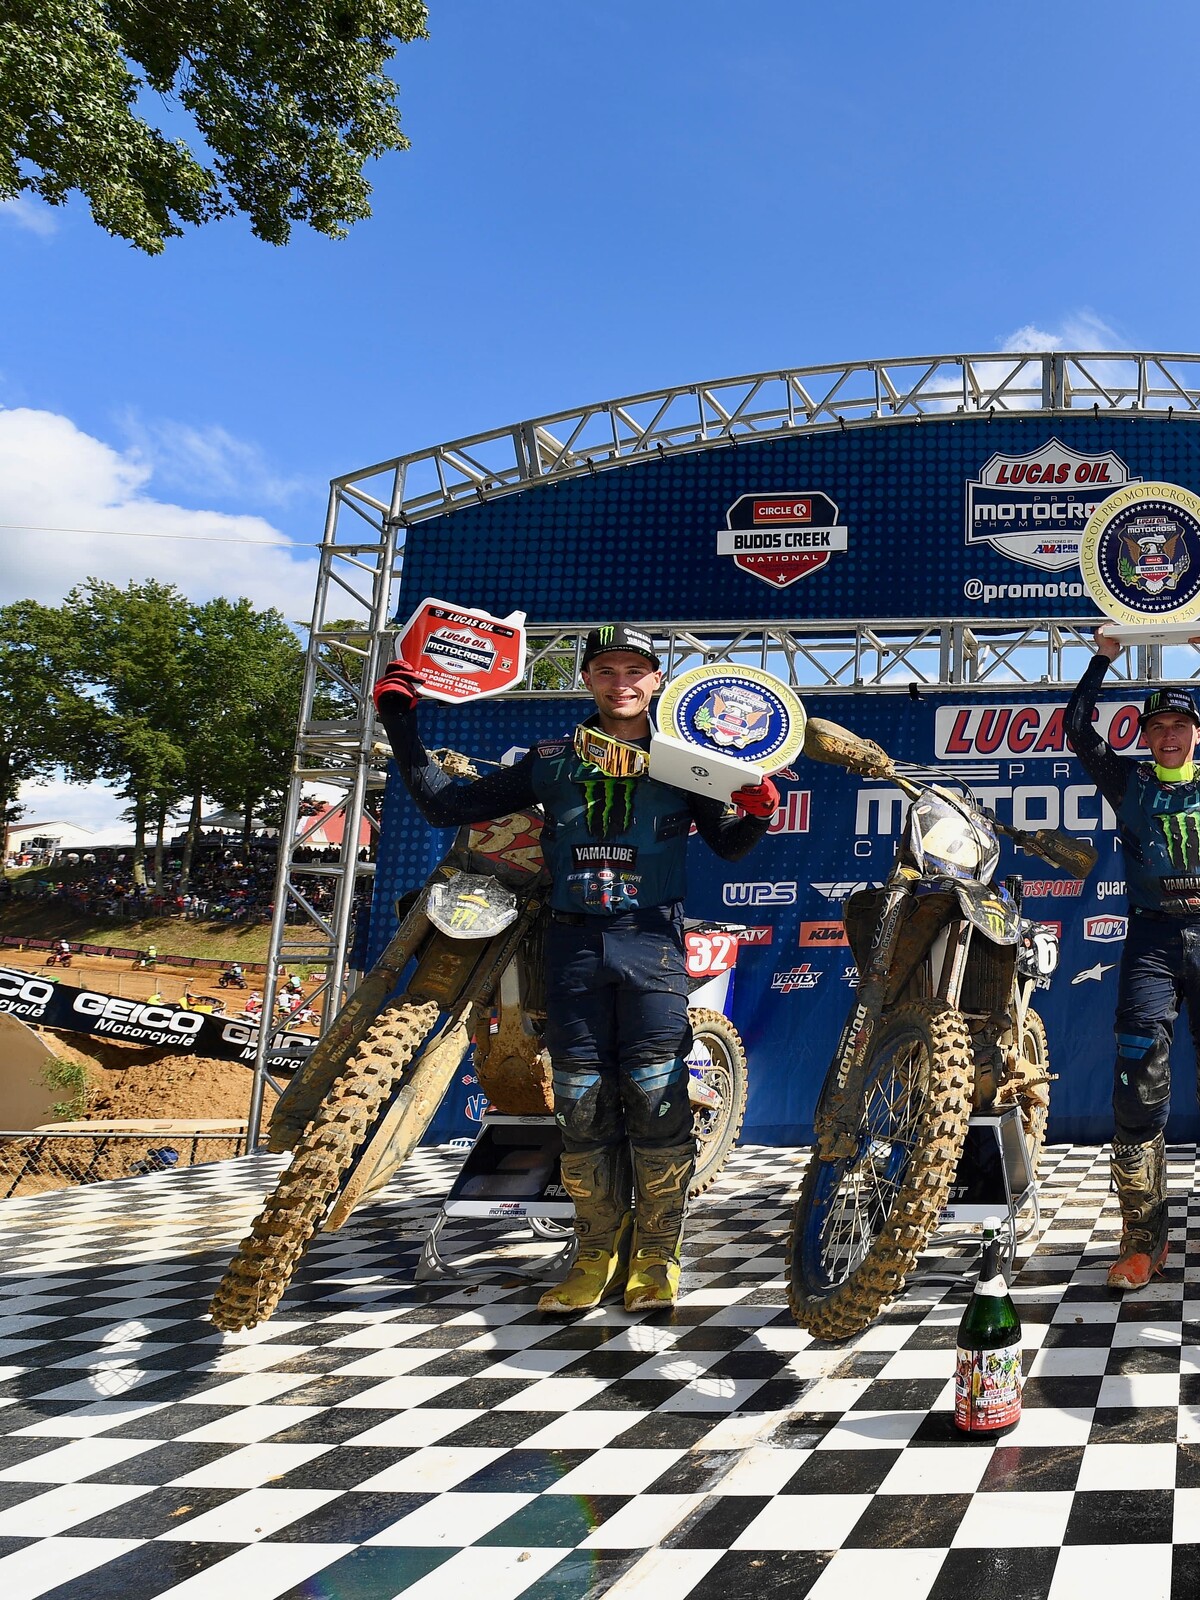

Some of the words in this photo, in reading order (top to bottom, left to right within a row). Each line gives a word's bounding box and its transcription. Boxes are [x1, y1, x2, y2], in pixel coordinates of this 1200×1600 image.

[995, 462, 1071, 484] LUCAS
[1074, 462, 1112, 484] OIL
[1102, 497, 1123, 517] PRO
[1124, 486, 1198, 510] MOTOCROSS
[758, 506, 791, 515] CIRCLE
[974, 503, 1102, 520] MOTOCRO
[974, 519, 1082, 528] CHAMPION
[1089, 517, 1105, 535] OIL
[1127, 525, 1177, 534] MOTOCROSS
[734, 533, 782, 549] BUDDS
[784, 532, 831, 548] CREEK
[1032, 544, 1062, 554] AMA
[746, 554, 819, 564] NATIONAL
[1084, 537, 1096, 577] LUCAS
[964, 578, 1091, 604] @promotoc
[1089, 579, 1107, 602] 2021
[447, 612, 479, 627] LUCAS
[478, 621, 495, 632] OIL
[1120, 611, 1147, 624] FIRST
[1181, 607, 1196, 620] 250
[440, 630, 471, 645] LUCAS
[472, 638, 489, 650] OIL
[427, 641, 493, 665] MOTOCROSS
[425, 679, 444, 688] UGUST
[428, 674, 454, 685] POINTS
[454, 681, 482, 693] LEADER
[440, 672, 460, 681] BUDDS
[460, 678, 479, 687] CREEK
[662, 681, 687, 713] LUCAS
[685, 671, 705, 684] OIL
[705, 667, 728, 677] PRO
[731, 667, 792, 703] MOTOCROSS
[771, 703, 804, 767] CHAMPIONSHIP
[589, 745, 605, 758] 100%
[1008, 763, 1070, 780] PR
[970, 811, 983, 823] OIL
[575, 846, 633, 862] YAMALUBE
[723, 878, 798, 906] WPS
[808, 926, 844, 941] KTM
[1089, 921, 1123, 936] 100%
[687, 936, 728, 972] 32
[1033, 932, 1059, 974] 6
[773, 972, 823, 984] VERTEX
[72, 992, 204, 1034] GEICO
[93, 1017, 196, 1048] Motorcycle
[221, 1023, 319, 1051] GEIC
[837, 1003, 868, 1090] DUNLOP
